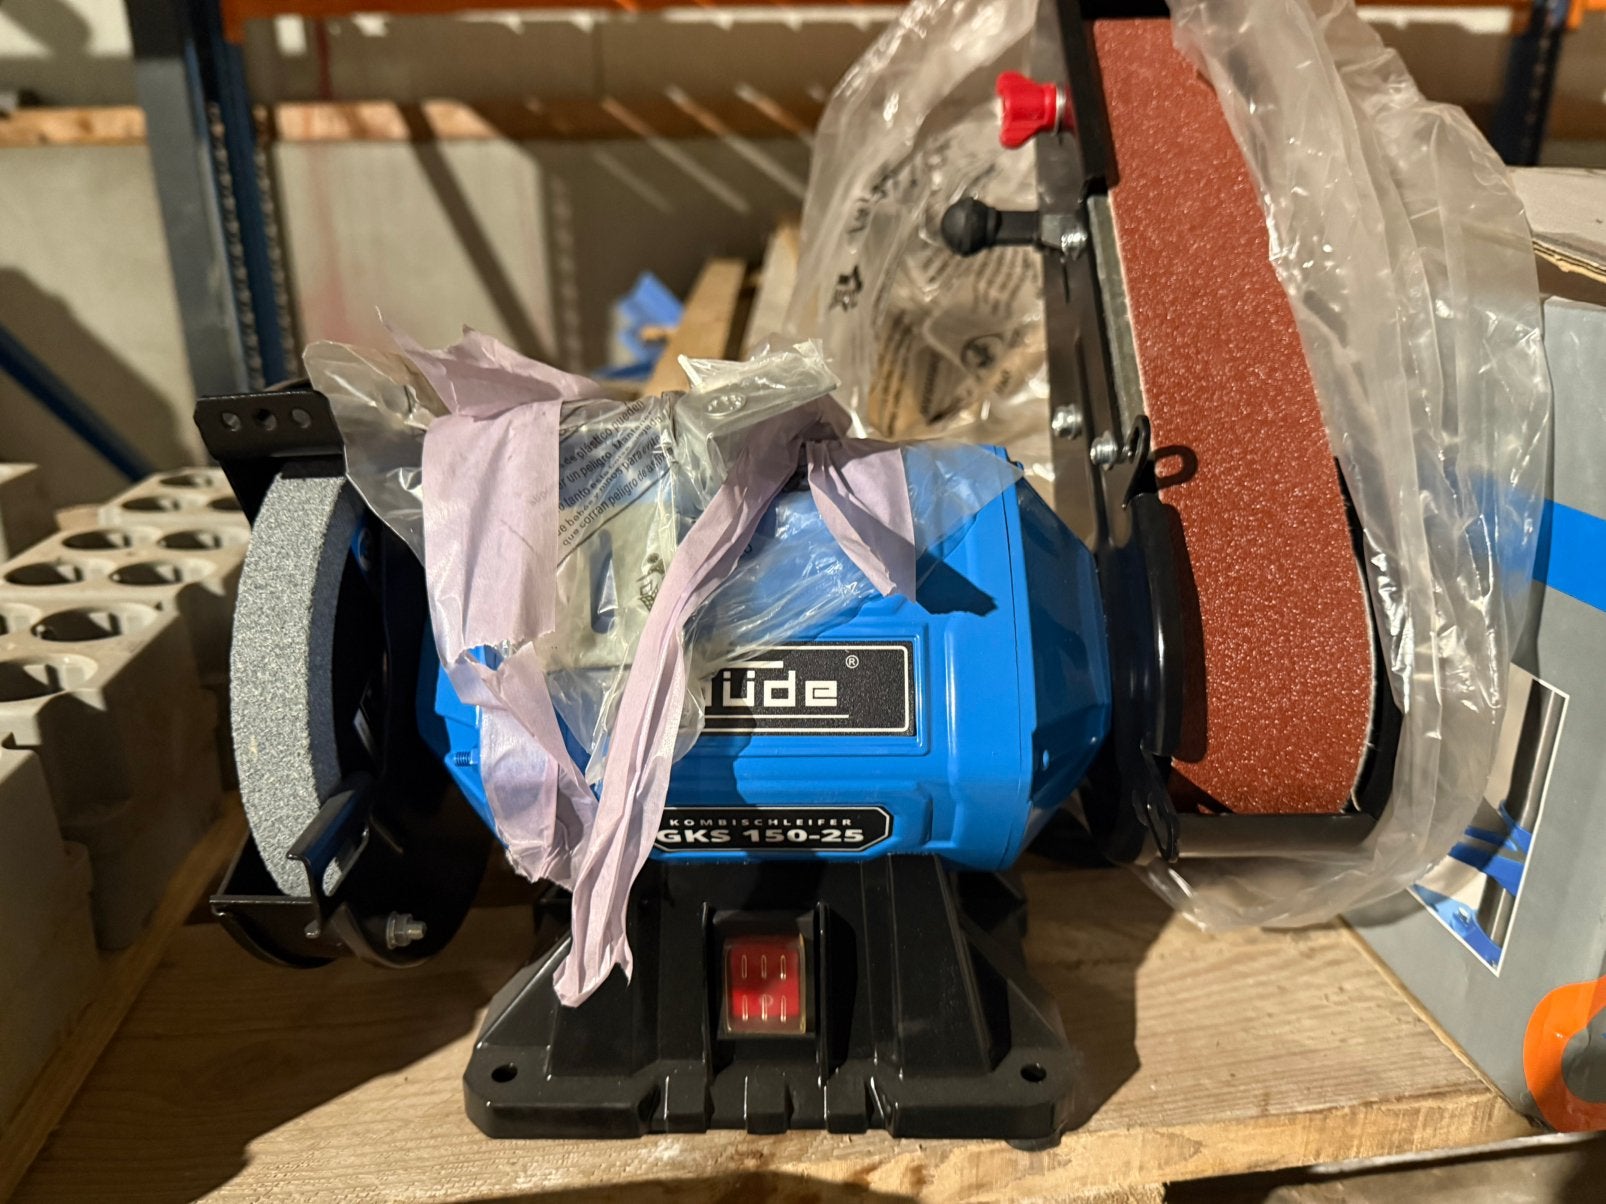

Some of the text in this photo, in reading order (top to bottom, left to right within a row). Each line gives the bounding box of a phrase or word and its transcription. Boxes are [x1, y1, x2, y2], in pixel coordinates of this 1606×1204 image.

[576, 427, 613, 460] plástico
[611, 399, 645, 433] pueden
[621, 449, 642, 472] para
[566, 470, 581, 484] un
[563, 486, 591, 508] tanto
[562, 528, 580, 547] que
[579, 500, 609, 528] corran
[608, 477, 638, 507] peligro
[669, 818, 852, 827] KOMBISCHLEIFER
[656, 828, 864, 843] GKS 150-25
